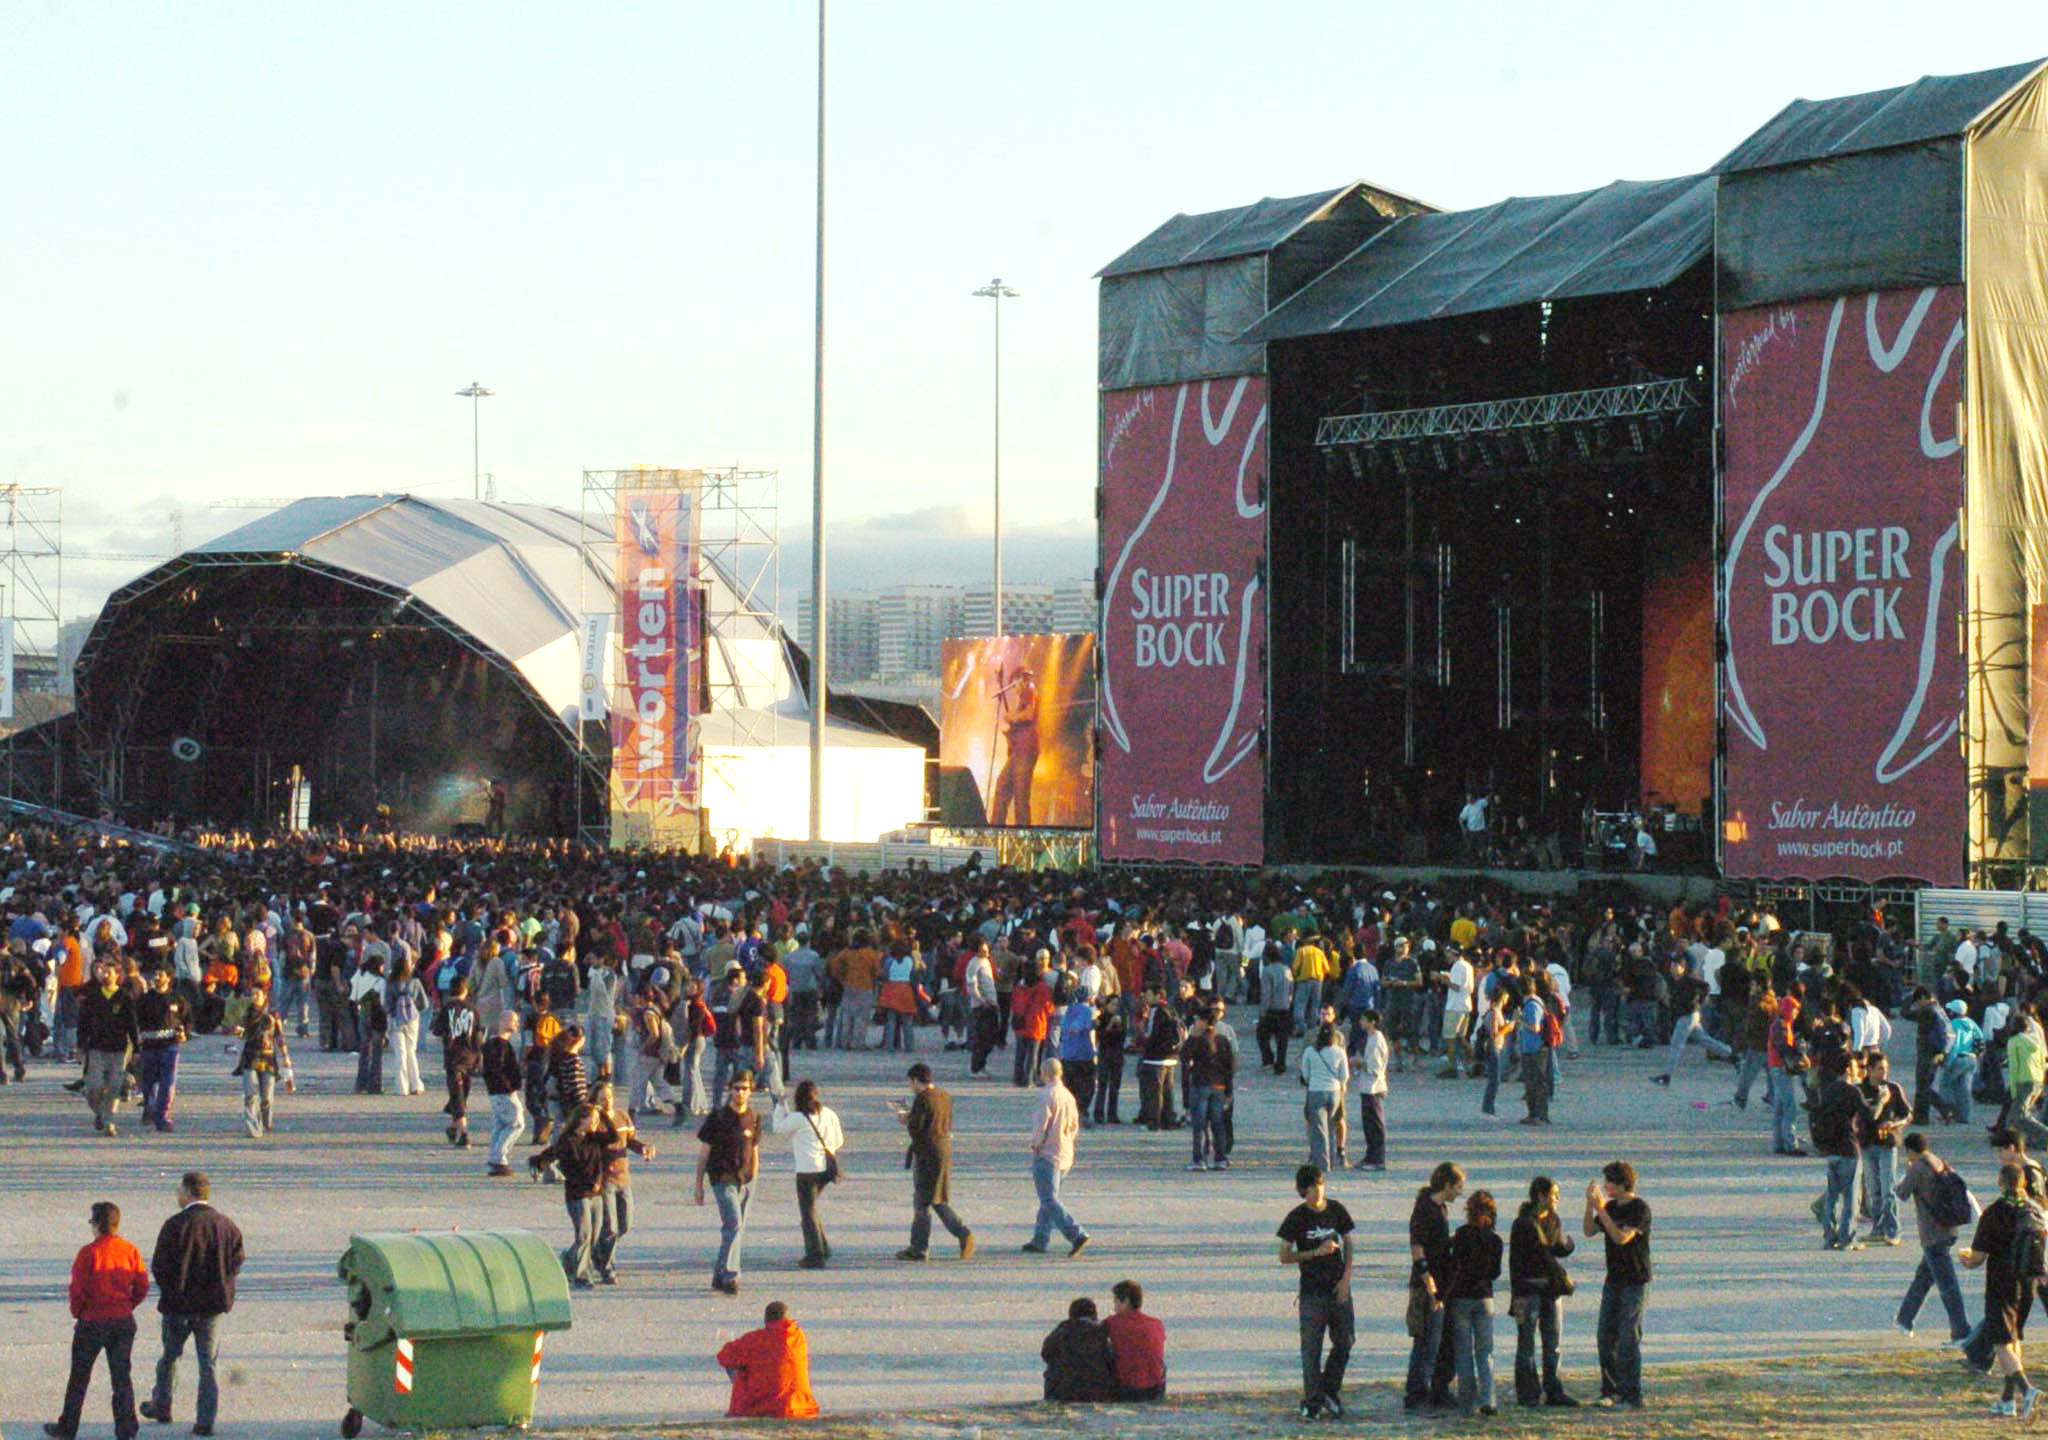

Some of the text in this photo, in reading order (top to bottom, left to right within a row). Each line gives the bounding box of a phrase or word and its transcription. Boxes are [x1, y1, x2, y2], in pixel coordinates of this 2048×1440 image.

[1764, 524, 1912, 588] SUPER
[1131, 567, 1229, 619] SUPER
[1772, 586, 1905, 645] BOCK
[1136, 622, 1226, 667] BOCK
[632, 568, 666, 773] worten
[1131, 793, 1167, 819] Sabor
[1768, 798, 1916, 829] Sabor Autêntico
[1137, 828, 1222, 846] www.superbock.pt
[1777, 838, 1905, 859] www.superbock.pt
